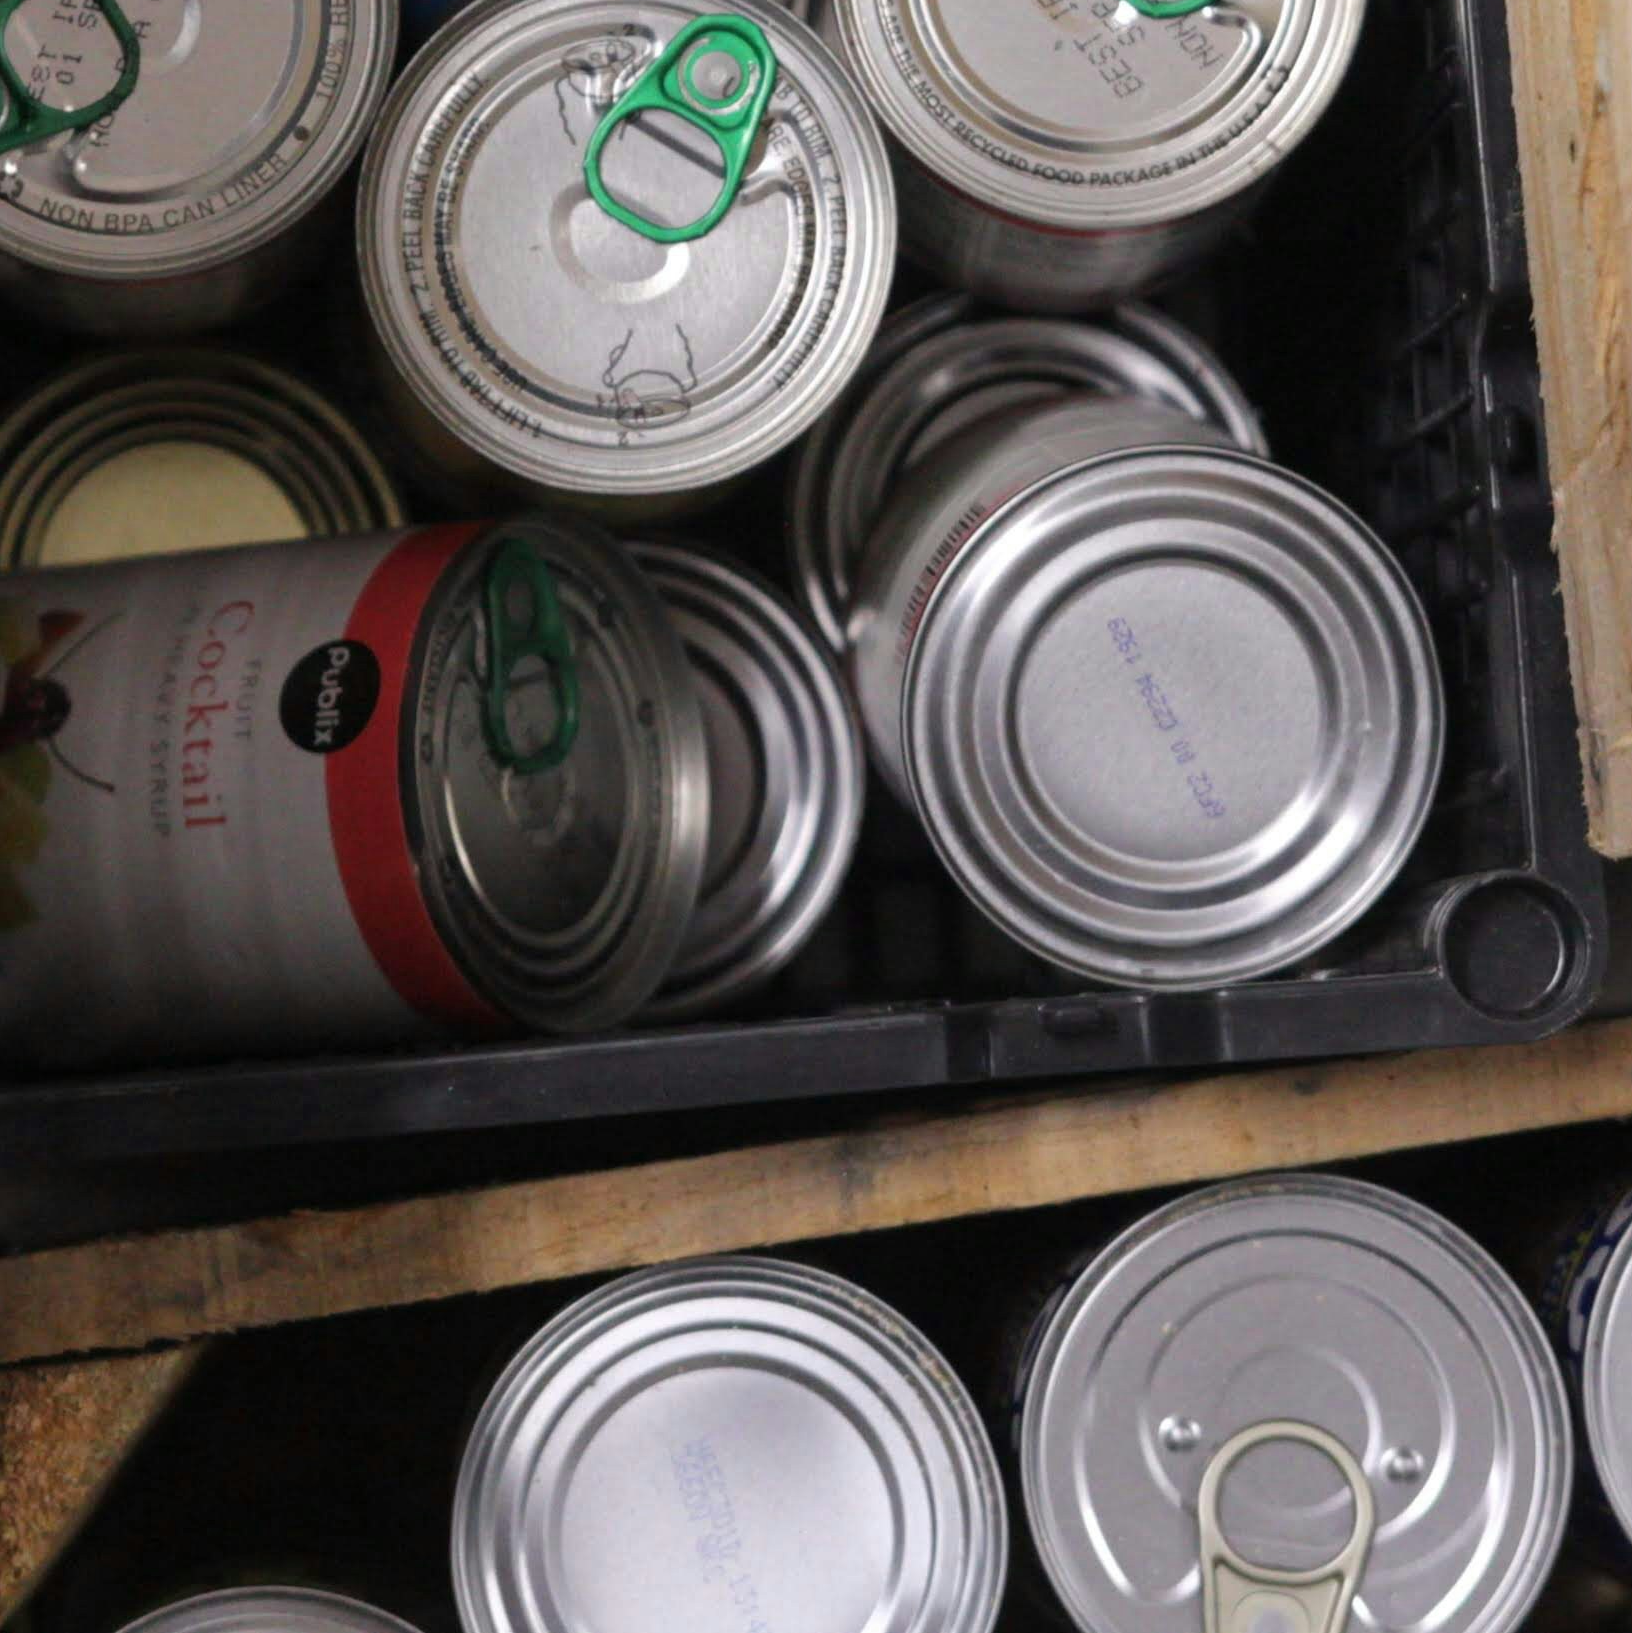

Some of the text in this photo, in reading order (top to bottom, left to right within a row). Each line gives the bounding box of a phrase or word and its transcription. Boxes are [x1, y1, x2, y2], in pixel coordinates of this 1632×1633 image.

[311, 37, 349, 104] 100%
[881, 12, 905, 47] ARE
[893, 48, 921, 81] THE
[912, 78, 956, 127] MOST
[950, 117, 1030, 175] RECYCLED
[1029, 160, 1085, 186] FOOD
[1090, 160, 1174, 187] PACKAGE
[1174, 151, 1198, 172] IN
[1197, 132, 1229, 160] THE
[1073, 32, 1146, 100] BEST
[411, 62, 490, 169] CAREFULLY.
[786, 97, 814, 125] TO
[801, 121, 835, 165] RIM.
[37, 148, 290, 232] NON BPA CAN LINER
[401, 168, 430, 219] BACK
[828, 195, 847, 242] PEEL
[400, 227, 426, 273] PEEL
[406, 272, 430, 296] 2.
[823, 245, 852, 295] BACK
[763, 296, 840, 395] CAREFULLY.
[181, 599, 256, 831] Cocktail
[234, 658, 263, 742] FRUIT
[310, 644, 352, 747] Publix
[147, 634, 189, 838] HEAVY SYRUP
